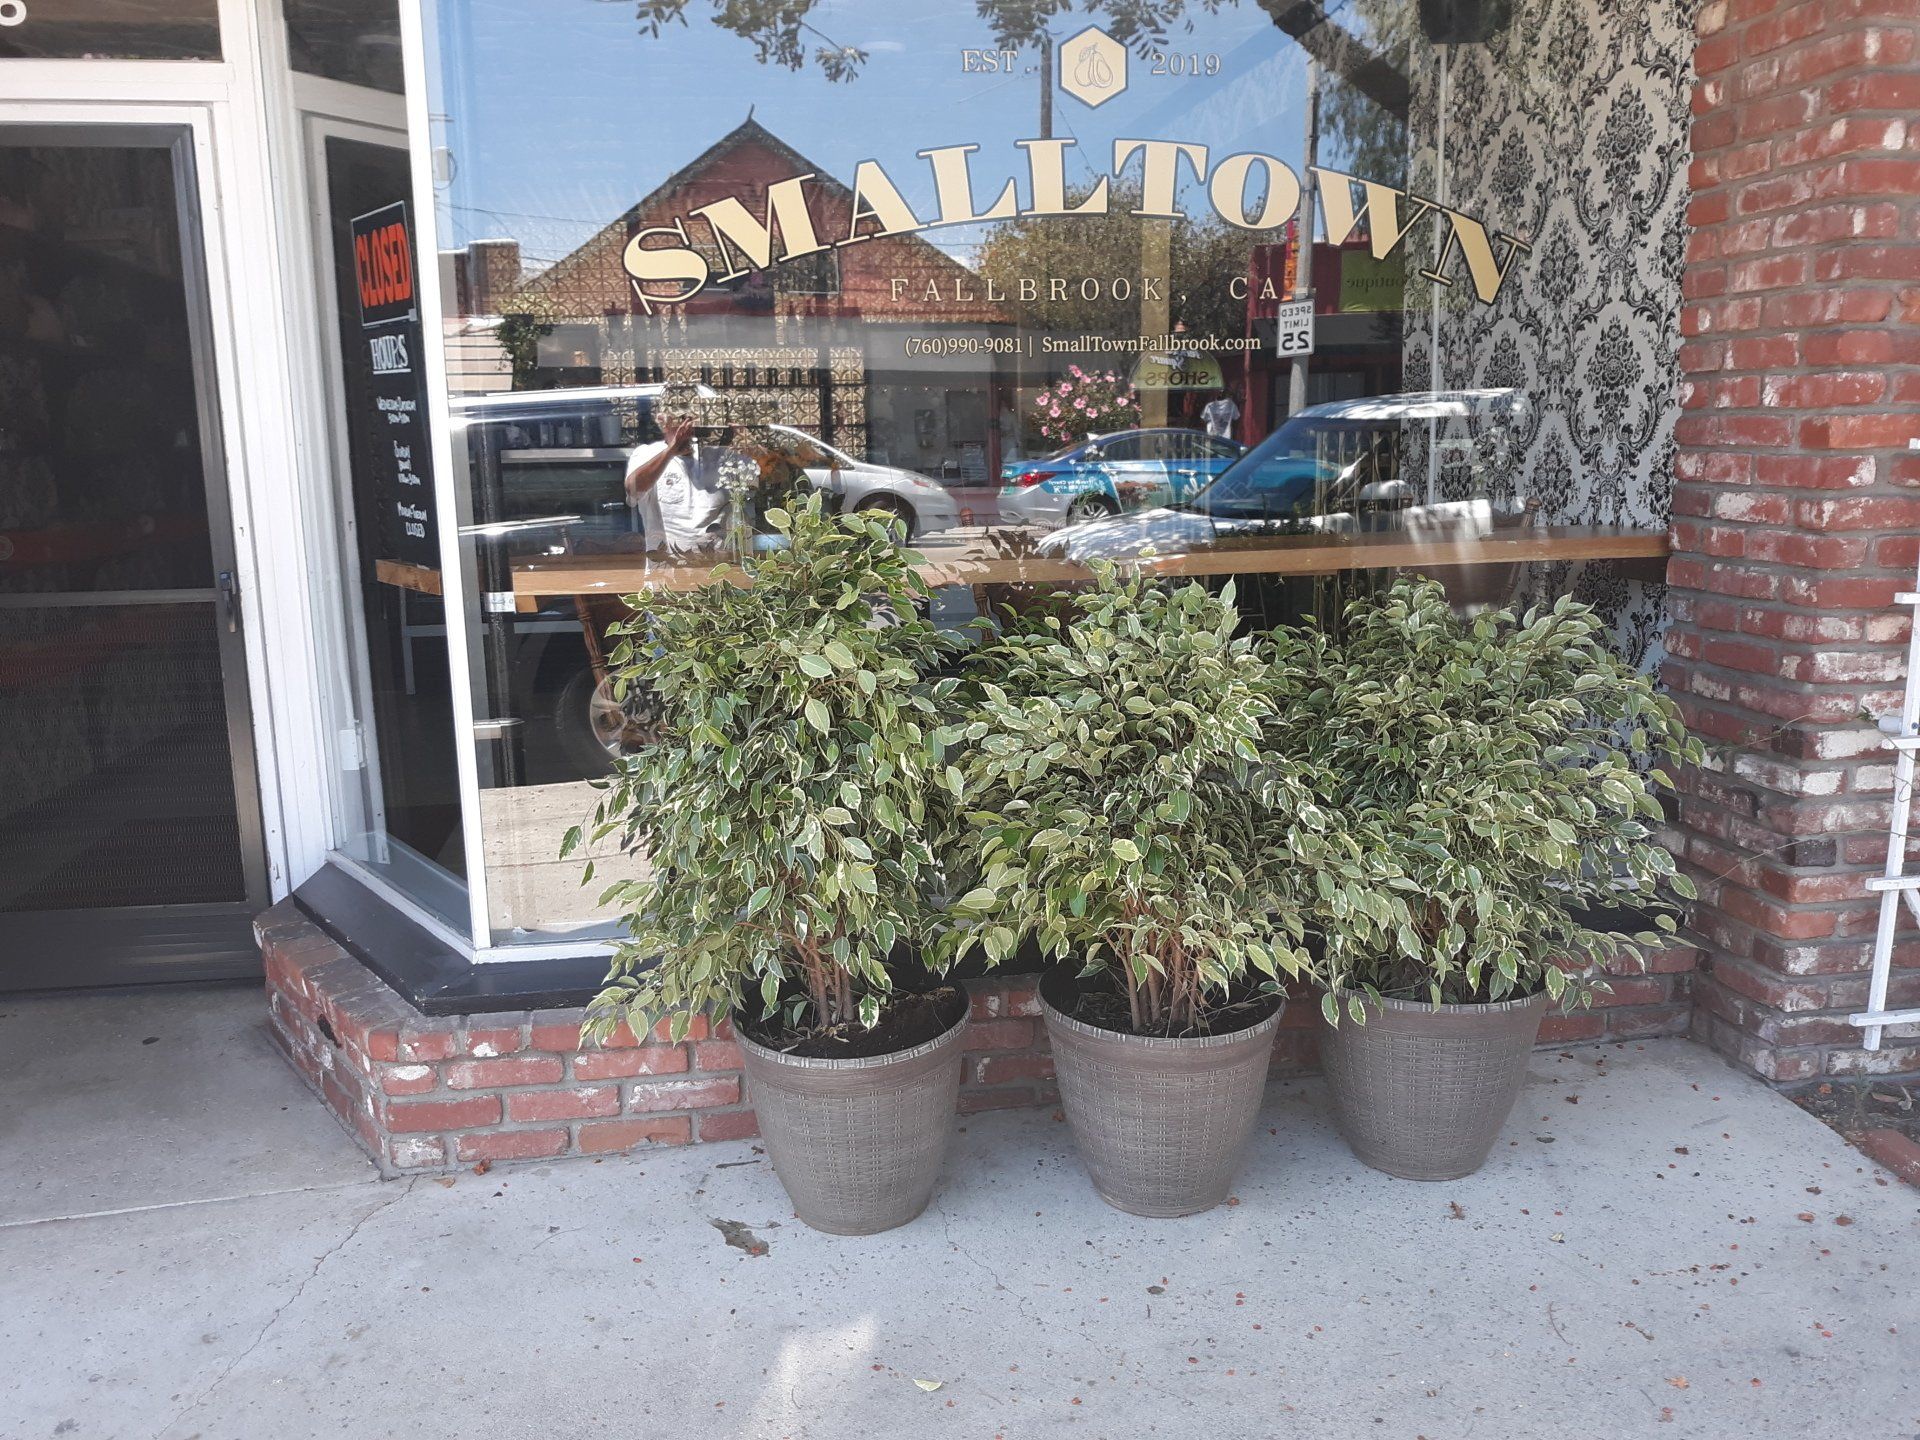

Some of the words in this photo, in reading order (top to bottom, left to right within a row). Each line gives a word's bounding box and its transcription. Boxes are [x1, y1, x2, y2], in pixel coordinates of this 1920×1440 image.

[1150, 52, 1222, 75] 2019
[355, 222, 411, 308] CLOSED
[890, 277, 1187, 303] FALLBROOK,
[1229, 276, 1278, 300] CA
[370, 334, 409, 370] HOURS
[904, 336, 1023, 356] (760)990-9081
[1041, 334, 1262, 353] SmallTownFallbrook.com
